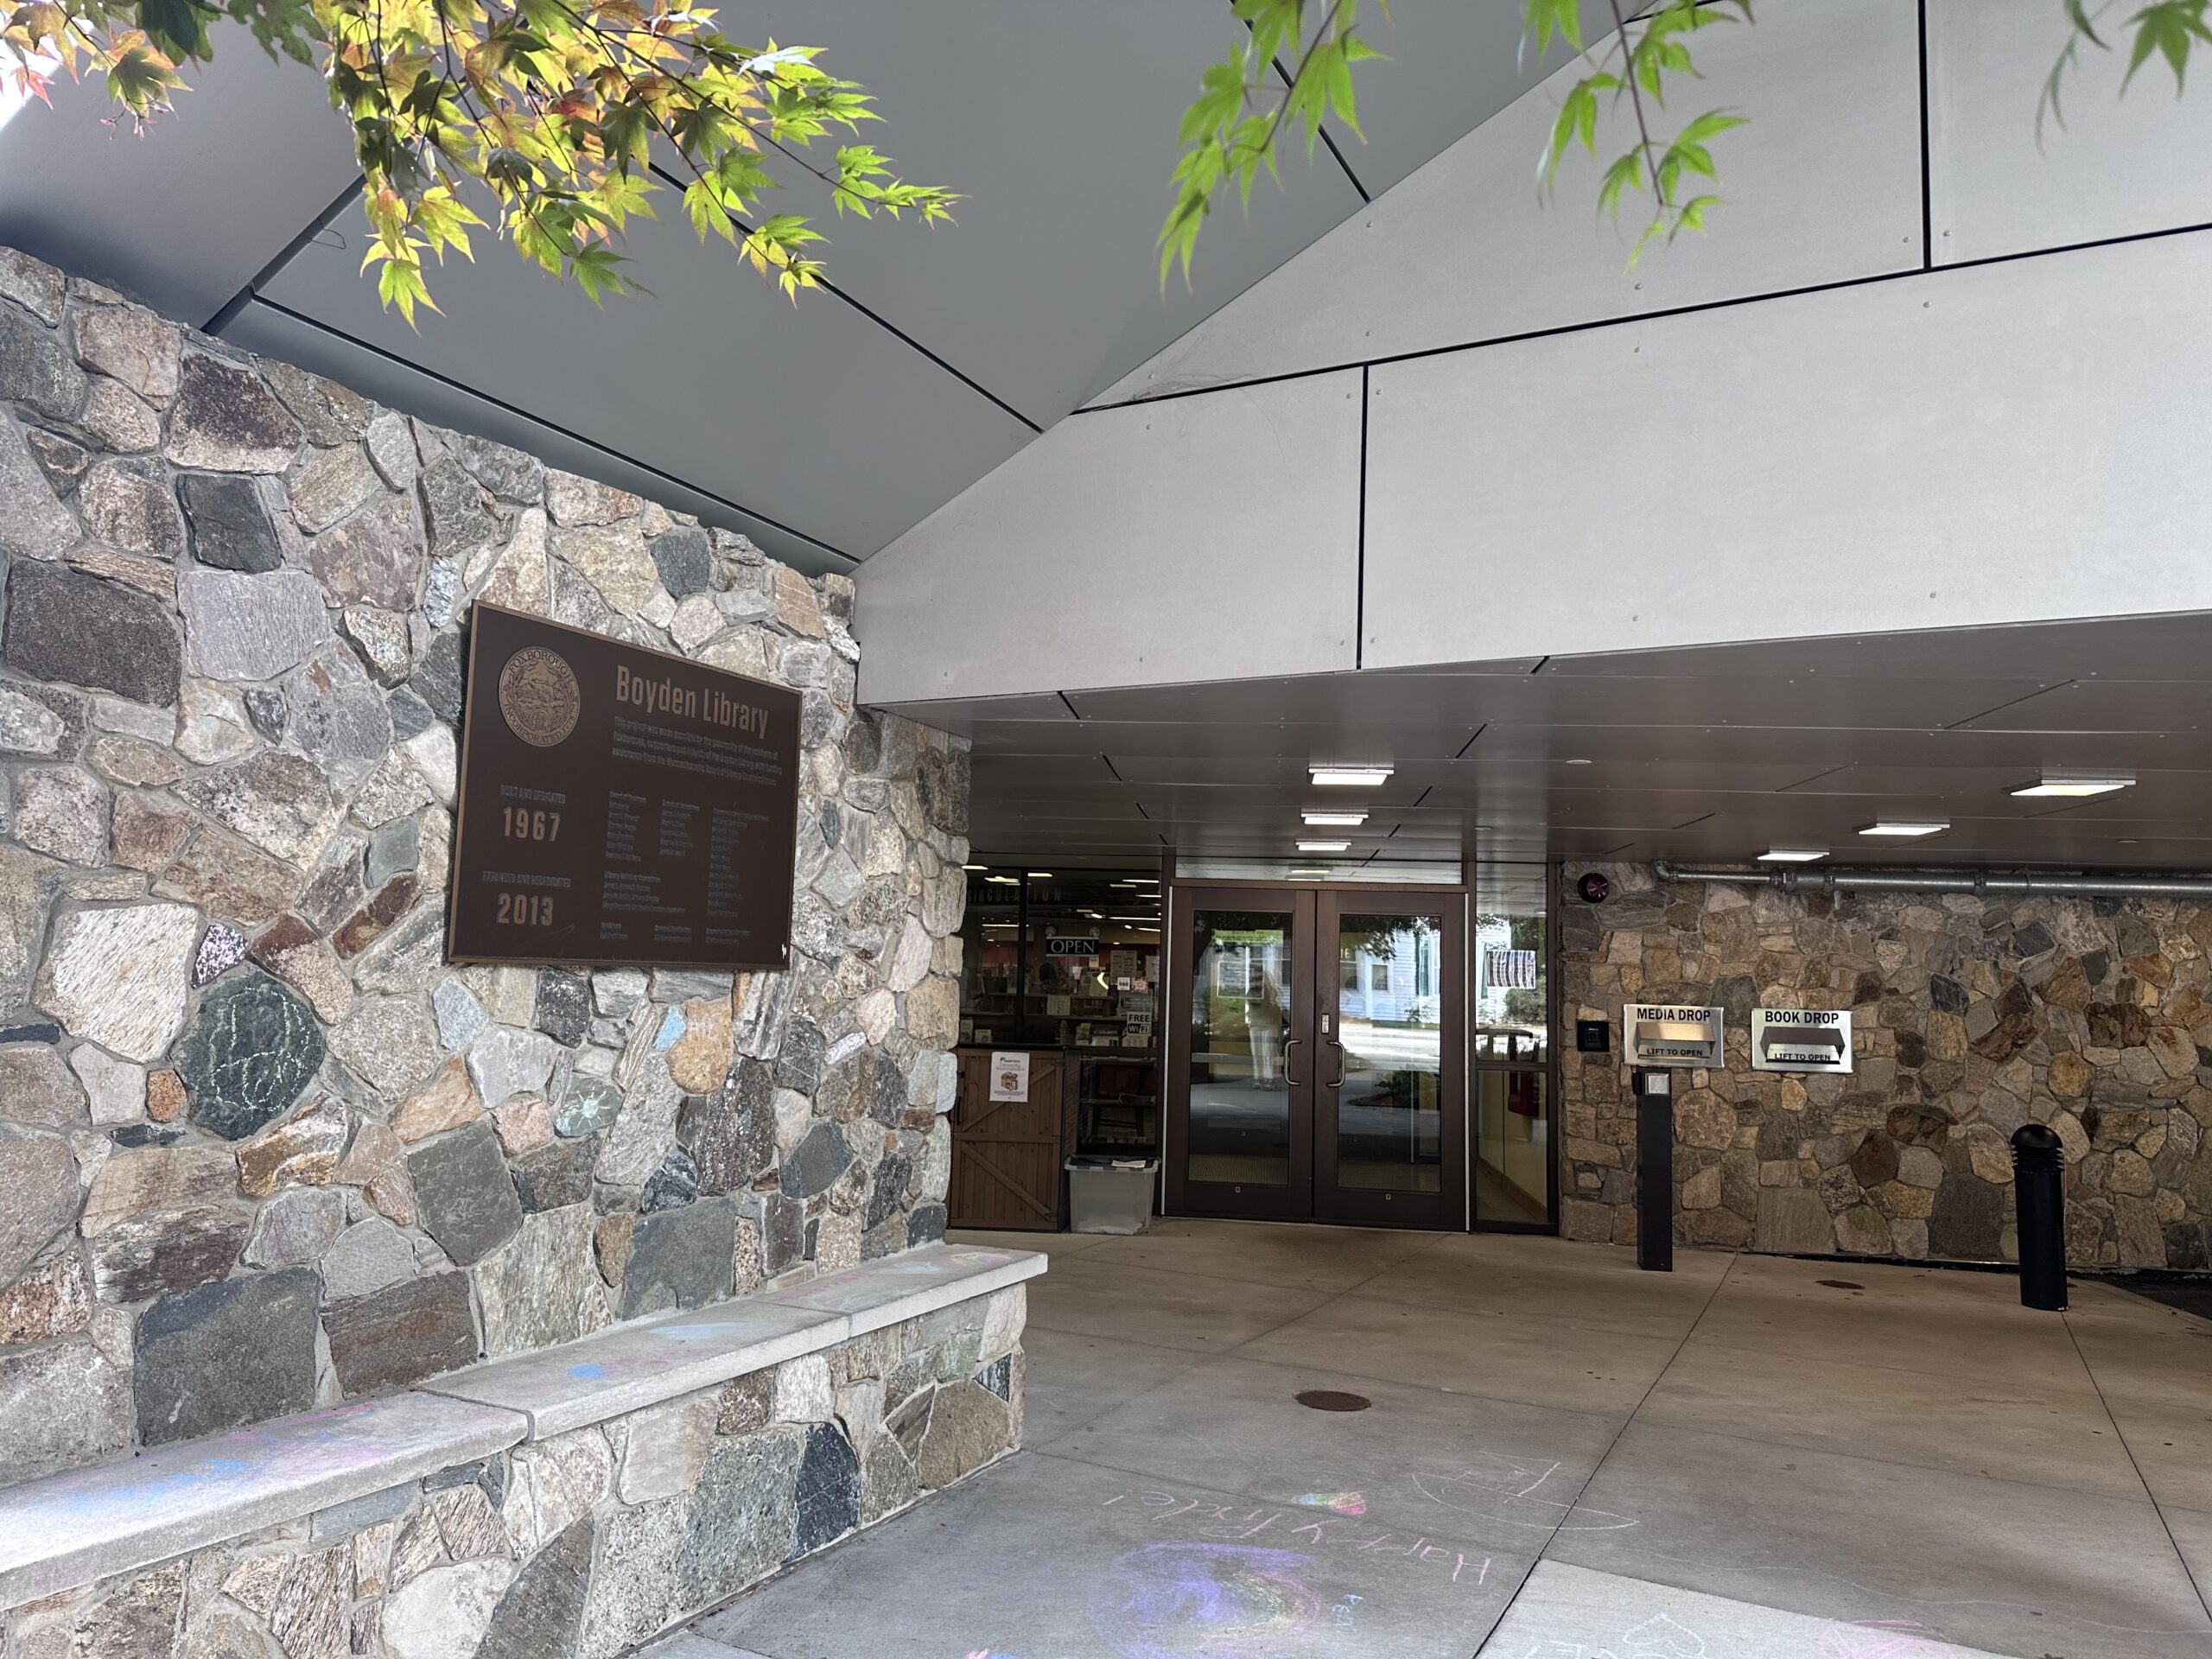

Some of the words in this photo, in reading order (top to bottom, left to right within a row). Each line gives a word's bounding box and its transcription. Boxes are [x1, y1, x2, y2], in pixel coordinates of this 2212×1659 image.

[508, 650, 574, 683] FOXBOROUGH
[616, 664, 696, 718] Boyden
[702, 688, 769, 740] Library
[503, 806, 561, 842] 1967
[497, 893, 554, 926] 2013
[1051, 939, 1095, 953] OPEN
[1637, 1007, 1675, 1020] MEDIA
[1678, 1009, 1711, 1021] DROP
[1765, 1011, 1801, 1023] BOOK
[1804, 1012, 1840, 1024] DROP
[1291, 1518, 1494, 1586] Happy
